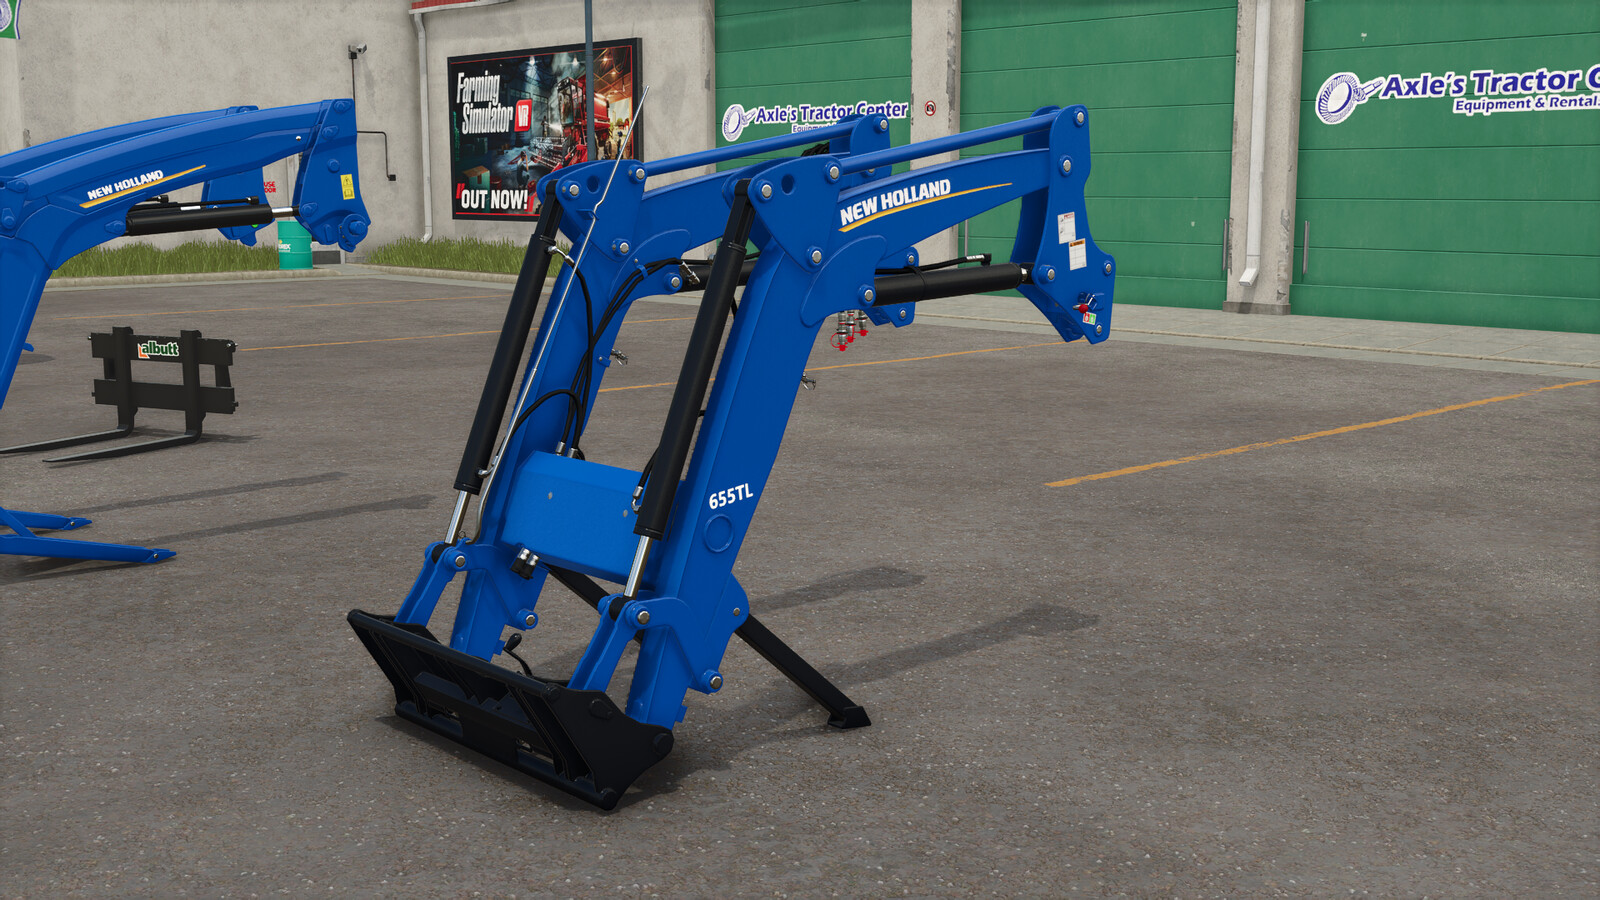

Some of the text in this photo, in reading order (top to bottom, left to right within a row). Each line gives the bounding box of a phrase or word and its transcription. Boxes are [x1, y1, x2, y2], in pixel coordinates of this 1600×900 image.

[457, 70, 501, 106] Farming
[1382, 75, 1465, 97] Axle's
[1473, 71, 1580, 94] Tractor
[462, 101, 530, 135] Simulator VR
[755, 106, 796, 123] Axle's
[801, 103, 853, 121] Tractor
[1455, 97, 1531, 115] Equipment
[1535, 97, 1545, 108] &
[88, 169, 164, 200] NEW HOLLAND
[461, 189, 528, 209] OUT NOW!
[840, 179, 951, 226] NEW HOLLAND
[141, 341, 178, 356] albutt
[708, 482, 754, 510] 655TL
